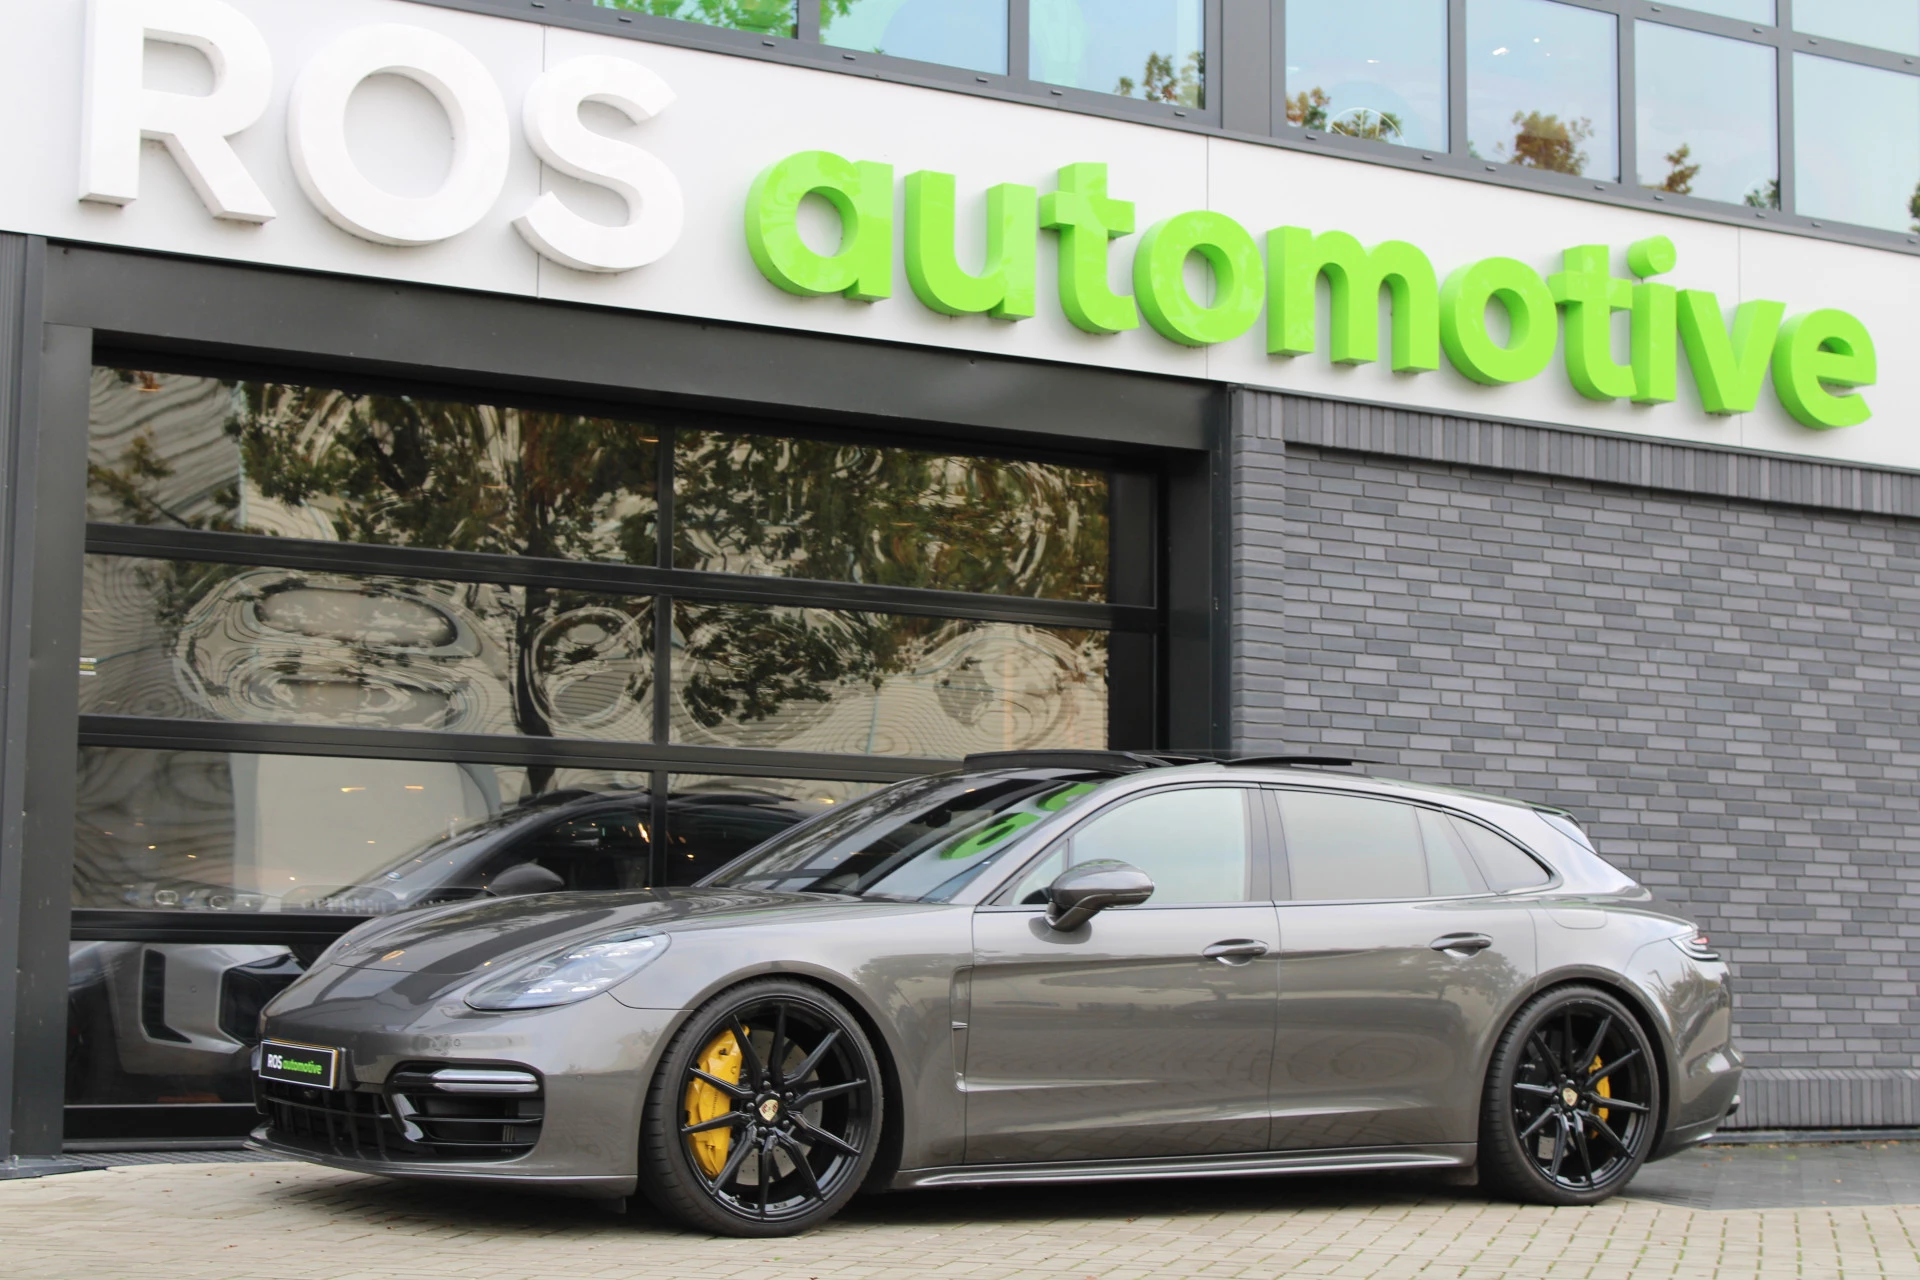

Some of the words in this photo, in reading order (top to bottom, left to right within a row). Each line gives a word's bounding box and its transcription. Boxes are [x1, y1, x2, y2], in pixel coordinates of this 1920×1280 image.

[78, 0, 684, 273] ROS
[744, 150, 1878, 429] automotive
[267, 1053, 283, 1070] ROS
[283, 1059, 322, 1075] automotive
